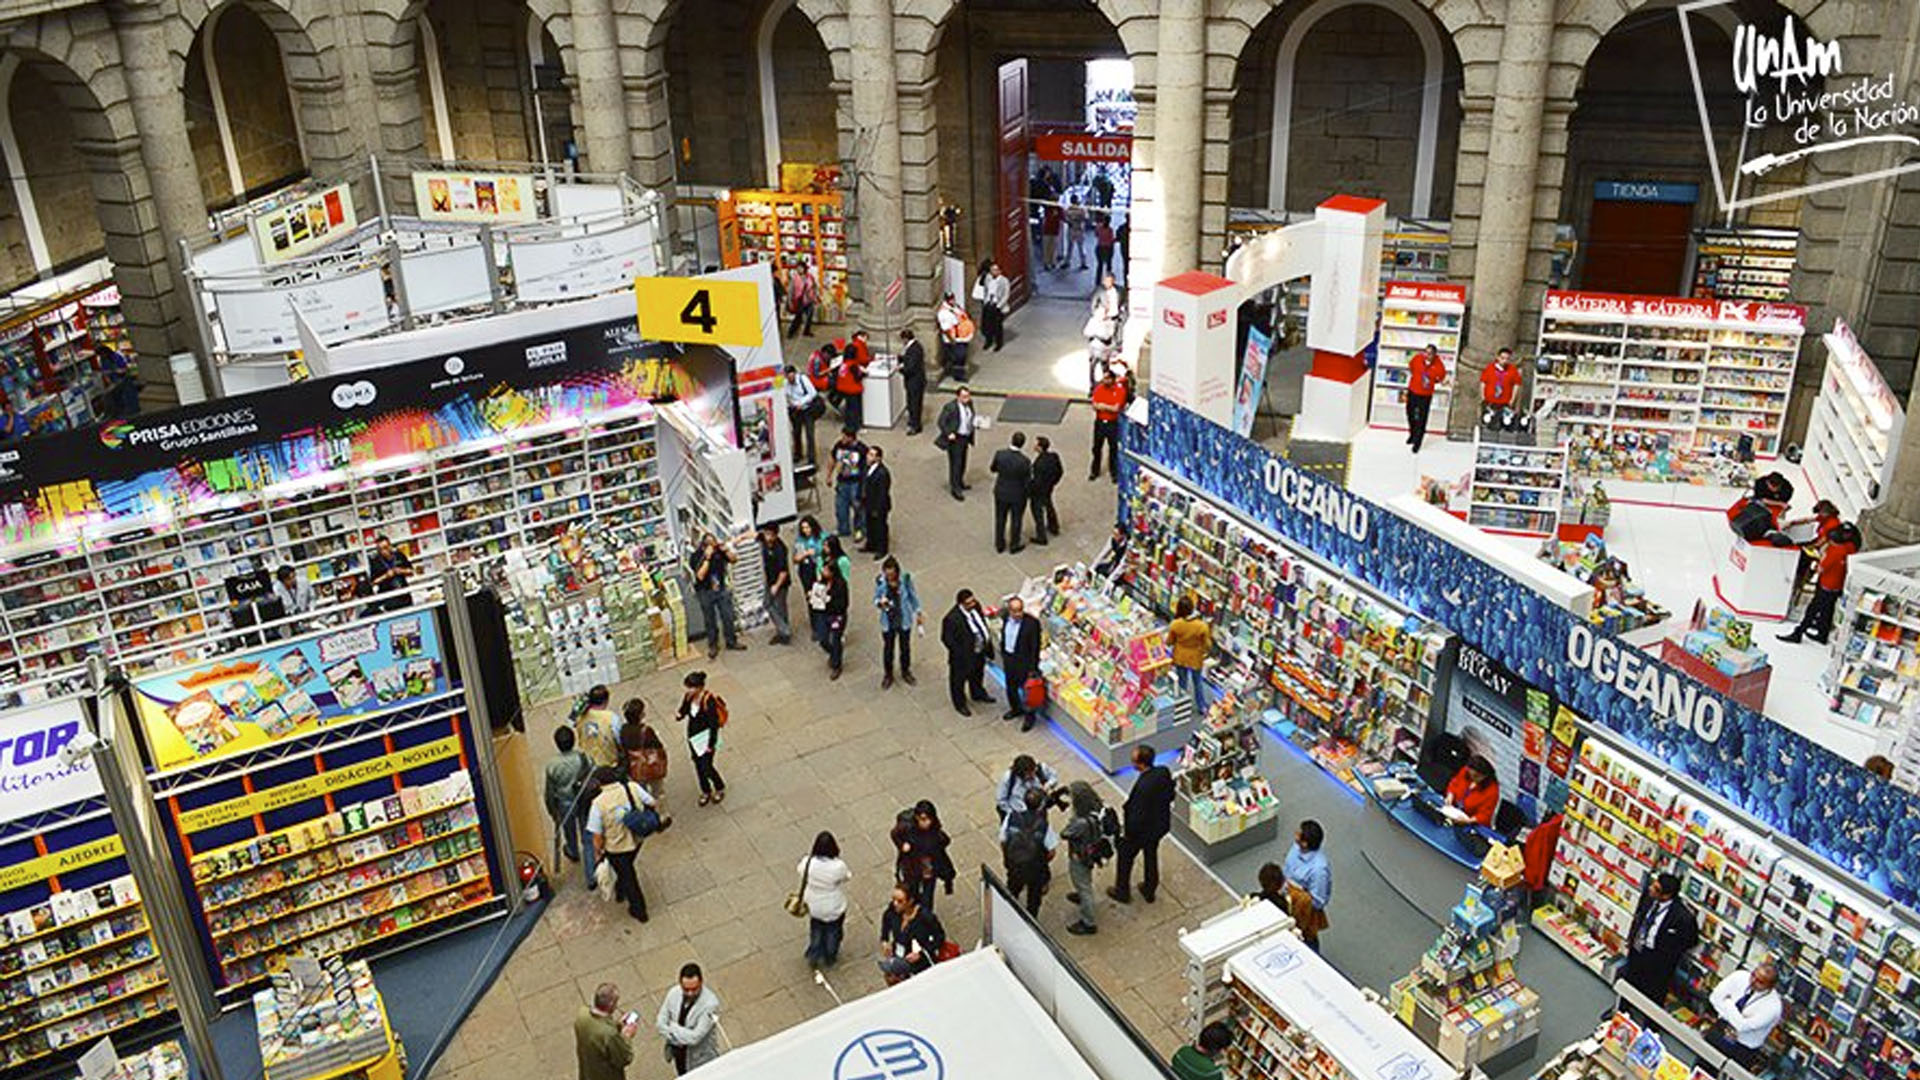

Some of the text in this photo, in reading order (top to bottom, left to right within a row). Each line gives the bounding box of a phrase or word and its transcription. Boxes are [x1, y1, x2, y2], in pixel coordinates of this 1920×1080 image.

[1061, 141, 1129, 156] SALIDA
[1612, 183, 1658, 198] TIENDA
[680, 289, 717, 334] 4
[1562, 294, 1627, 313] CÁTEDRA
[1646, 298, 1713, 319] CÁTEDRA
[337, 388, 372, 401] SUMA
[129, 408, 255, 445] PRISA EDICIONES
[160, 424, 258, 451] Grupo Santillana
[1265, 459, 1368, 542] OCEANO
[236, 580, 262, 593] CAJA
[1568, 625, 1724, 744] OCEANO
[402, 744, 450, 764] NOVELA
[325, 760, 393, 786] DIDÁCTICA
[182, 800, 249, 823] CON LOS PELOS
[59, 841, 115, 867] AJEDREZ
